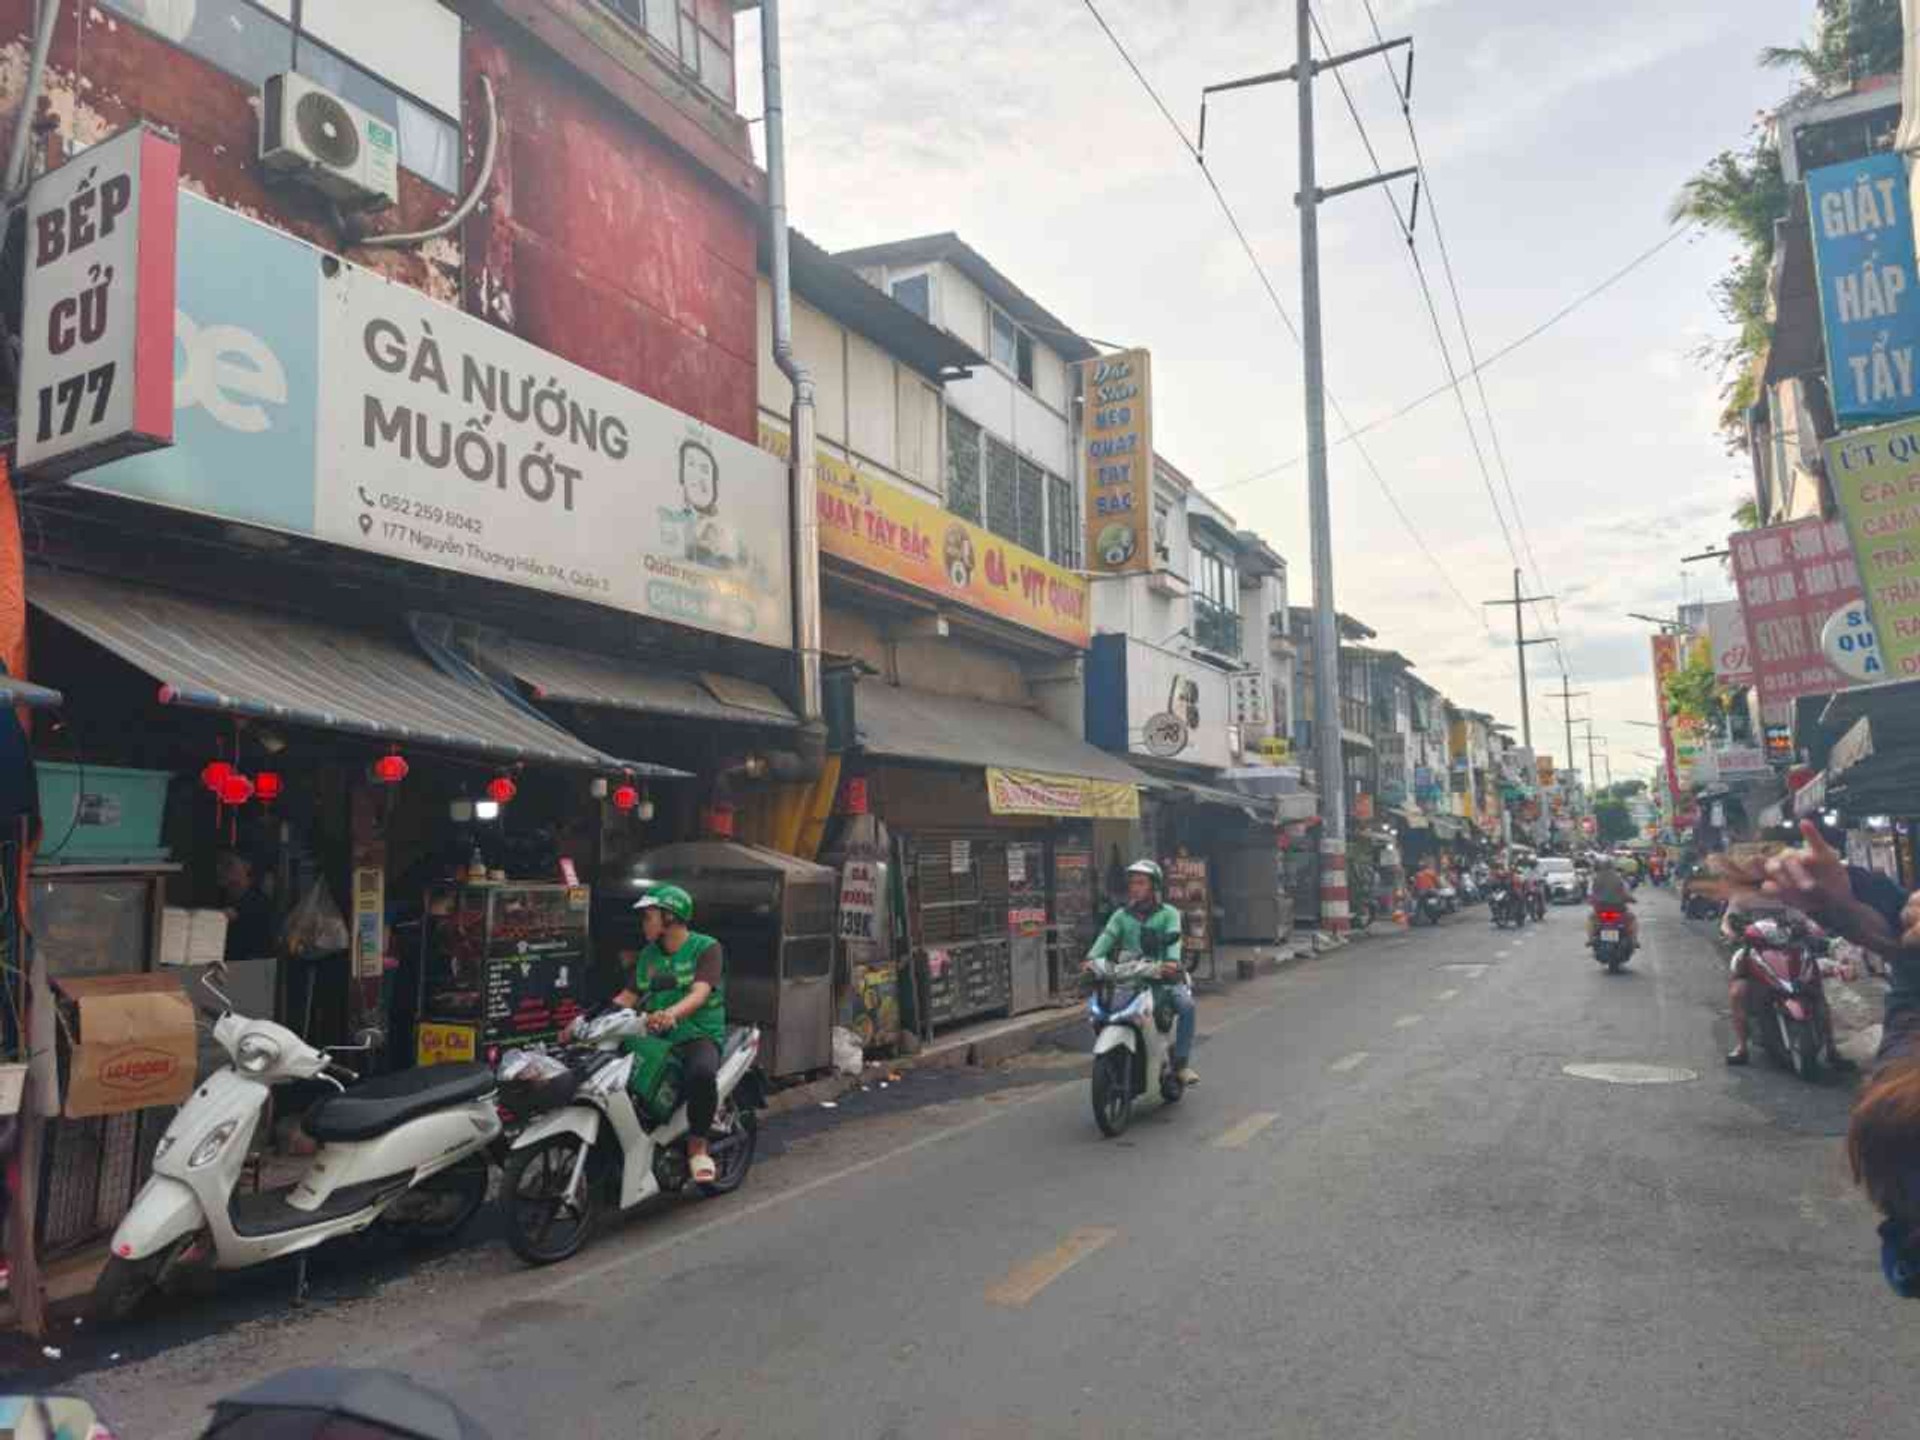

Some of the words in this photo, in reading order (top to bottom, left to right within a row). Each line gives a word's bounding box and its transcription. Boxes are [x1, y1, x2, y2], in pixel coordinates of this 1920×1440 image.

[36, 165, 131, 268] BẾP
[1821, 171, 1896, 242] GIẶT
[1834, 251, 1905, 324] HẤP
[36, 360, 116, 444] 177
[363, 317, 450, 395] GÀ
[462, 353, 629, 460] NƯỚNG
[363, 394, 507, 490] MUỐI
[518, 441, 583, 511] ỚT
[383, 521, 407, 541] 177
